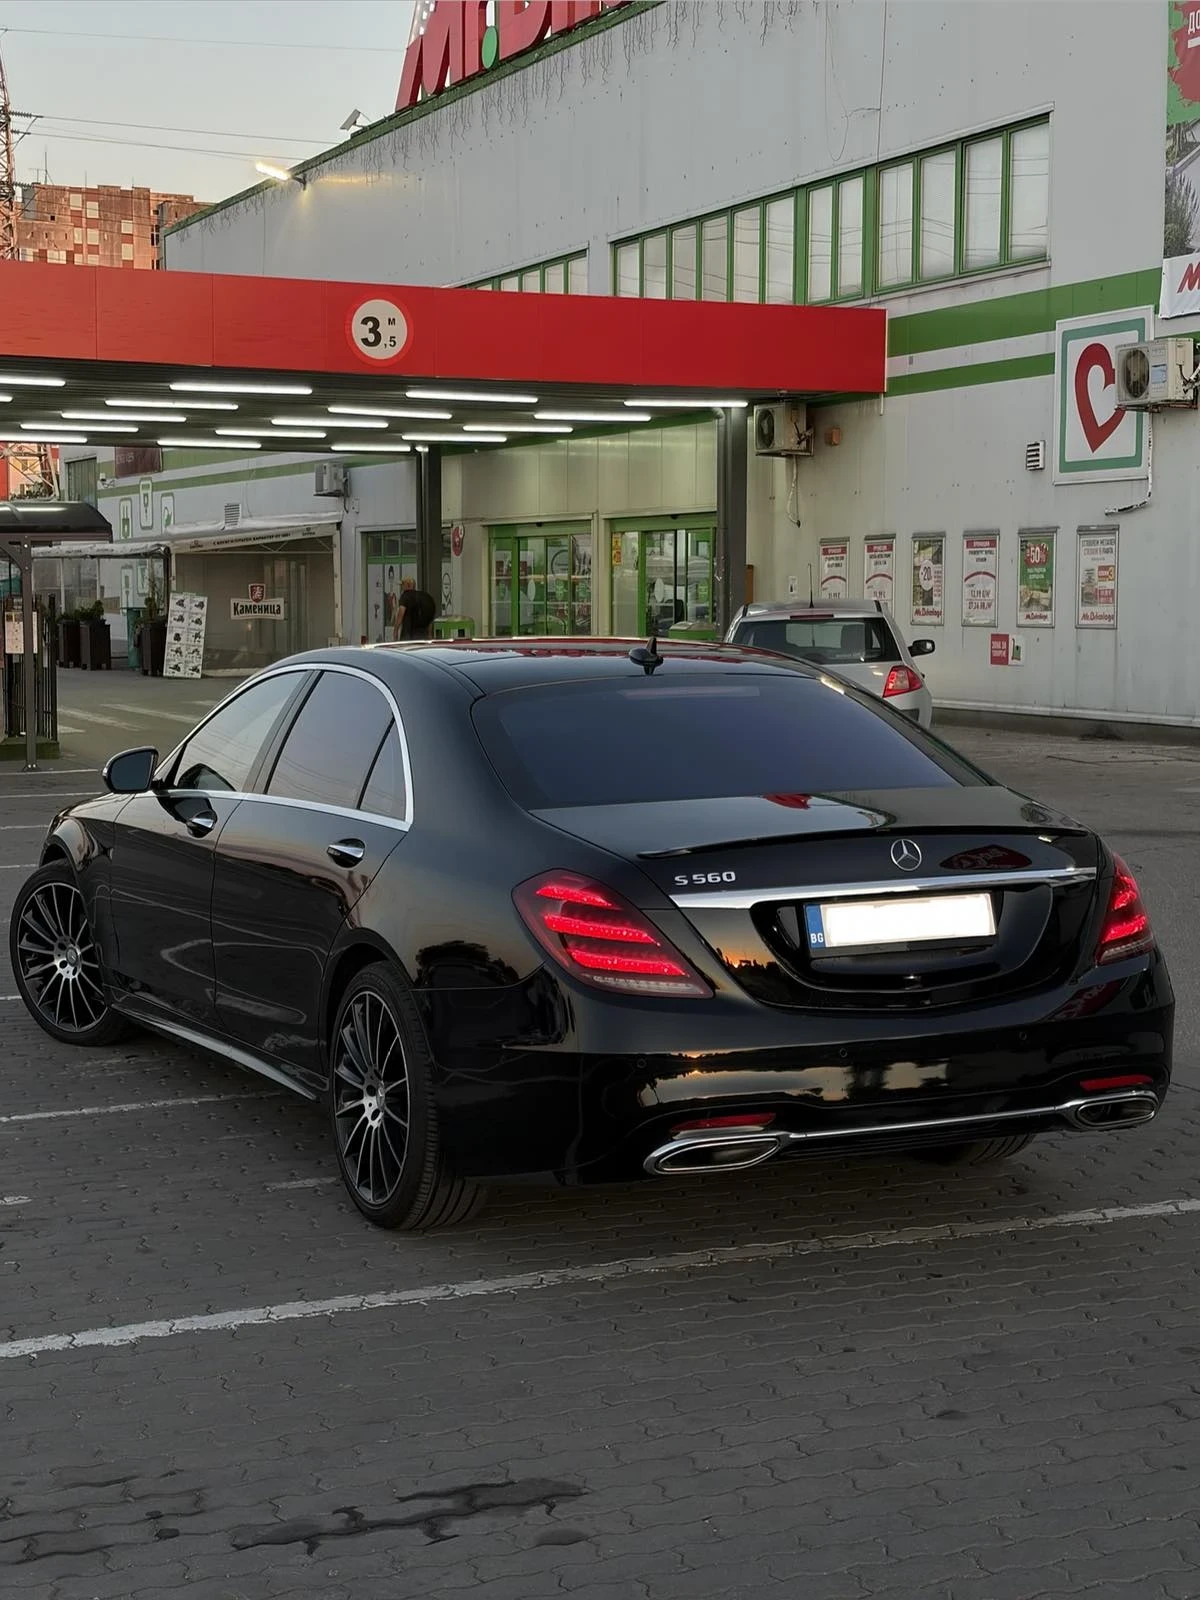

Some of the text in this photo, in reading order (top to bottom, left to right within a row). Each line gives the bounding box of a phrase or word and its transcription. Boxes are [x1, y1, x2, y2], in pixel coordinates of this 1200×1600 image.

[233, 602, 281, 617] Каменица
[674, 871, 736, 886] S 560
[810, 932, 824, 944] BG
